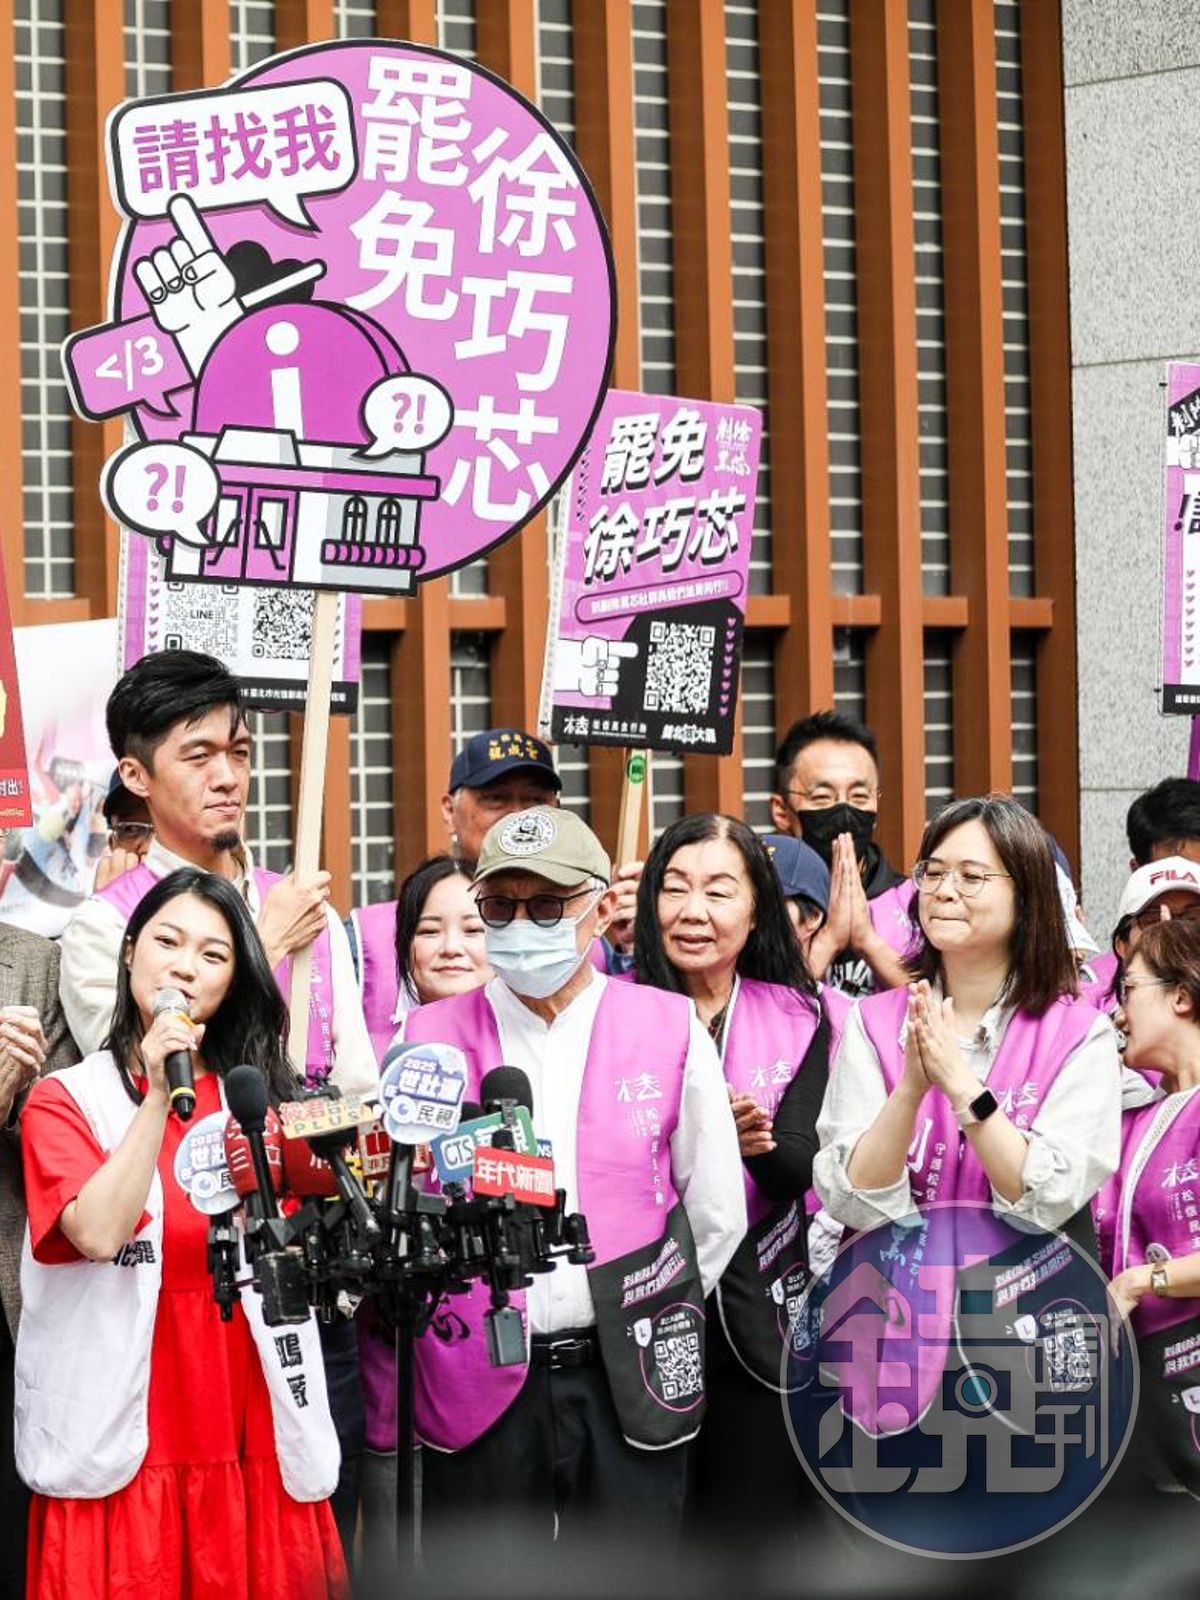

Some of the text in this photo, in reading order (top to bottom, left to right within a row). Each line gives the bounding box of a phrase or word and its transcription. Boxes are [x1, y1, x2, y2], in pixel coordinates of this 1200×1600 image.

[133, 103, 341, 194] 請找我
[345, 55, 473, 320] 罷免
[442, 128, 579, 522] 徐巧芯
[601, 407, 708, 495] 罷免
[583, 486, 746, 585] 徐巧芯
[190, 609, 215, 620] LINE
[1150, 869, 1198, 885] FILA
[403, 1057, 437, 1072] 2025
[416, 1104, 456, 1128] 民視
[190, 1143, 227, 1171] 世壯
[444, 1139, 474, 1168] CTS
[477, 1157, 551, 1195] 年代新聞
